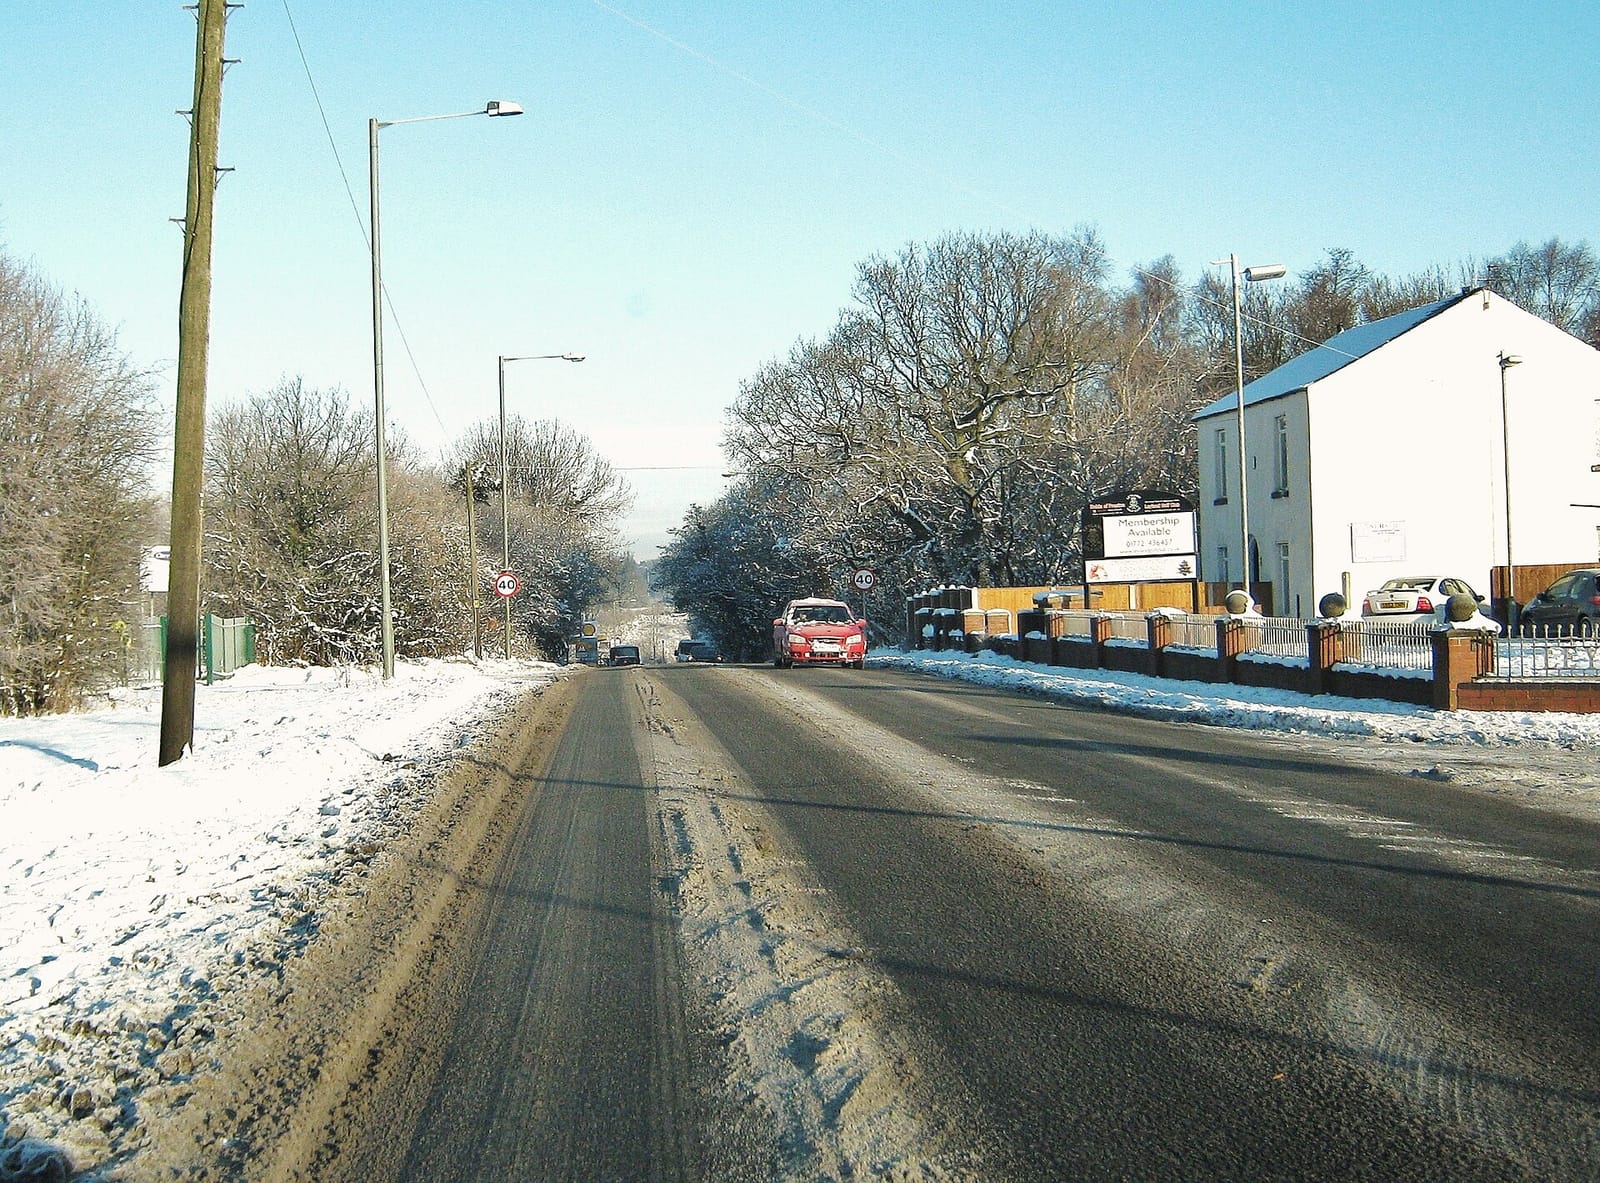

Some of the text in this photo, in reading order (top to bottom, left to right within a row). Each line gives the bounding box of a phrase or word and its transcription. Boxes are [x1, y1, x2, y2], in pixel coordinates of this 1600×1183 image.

[1118, 516, 1180, 527] Membership
[1127, 527, 1171, 537] Available
[1126, 540, 1145, 548] 01772
[498, 579, 515, 590] 40
[855, 574, 873, 585] 40
